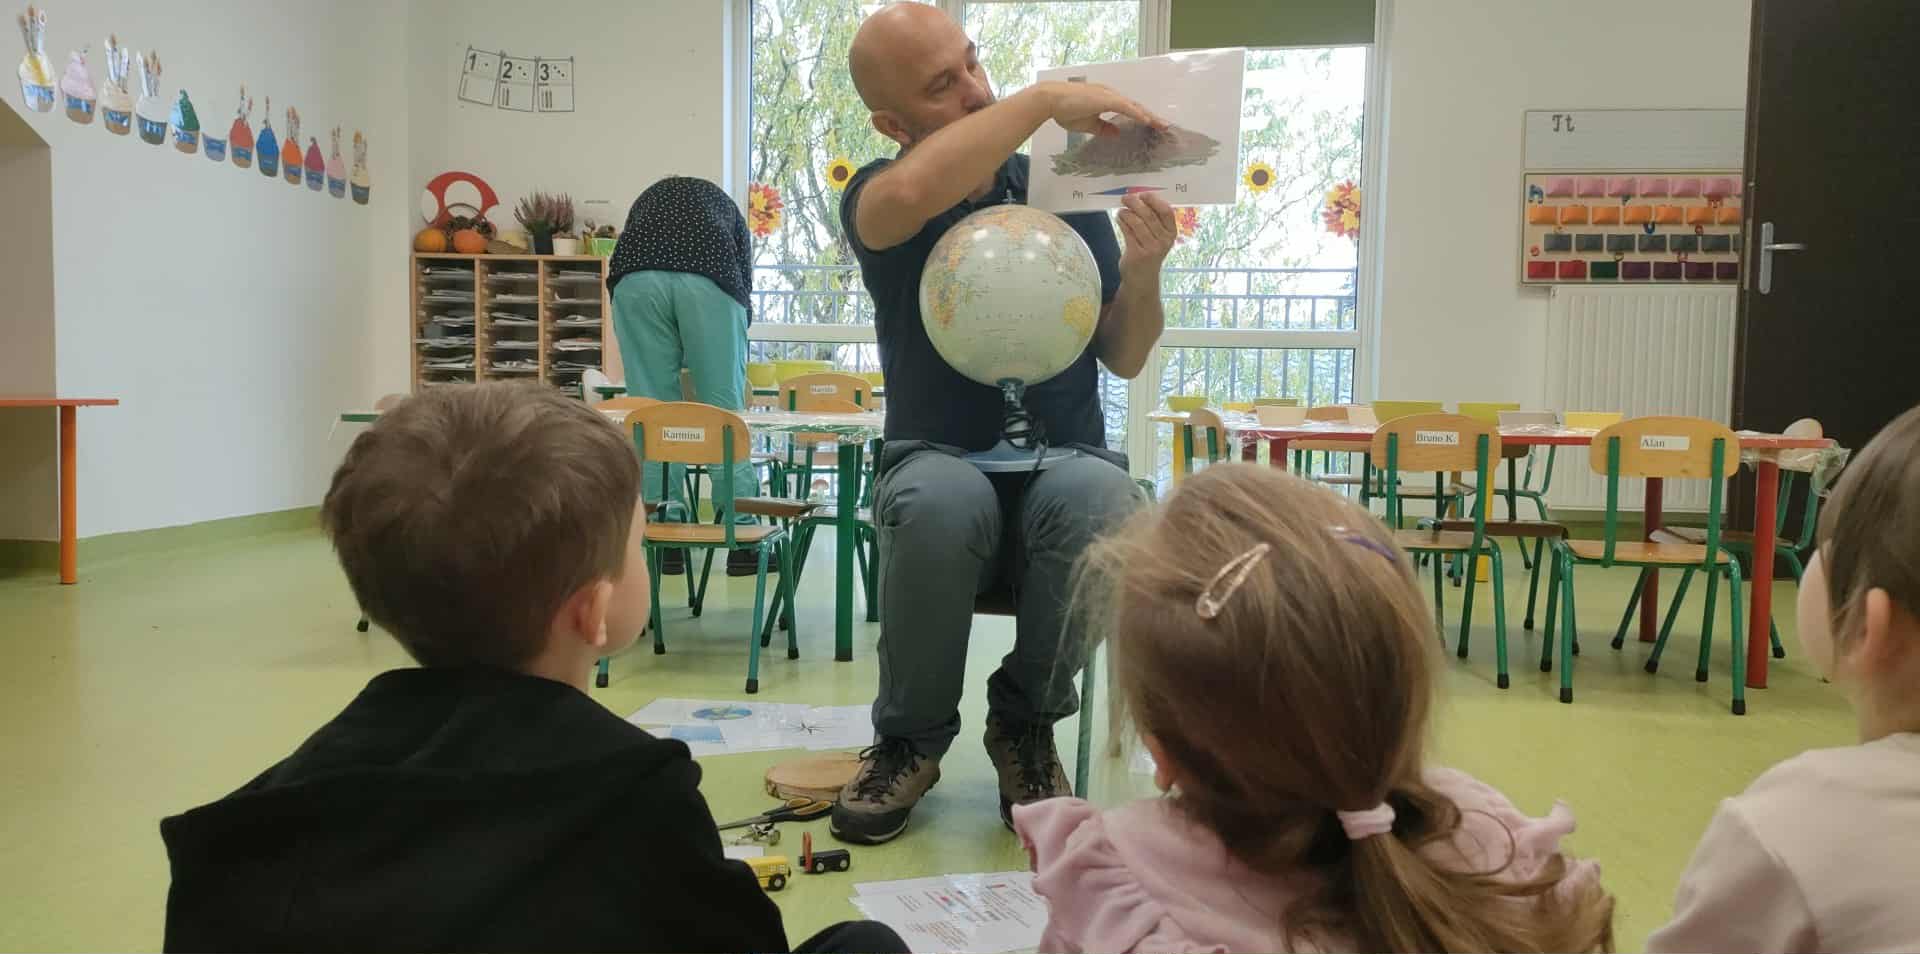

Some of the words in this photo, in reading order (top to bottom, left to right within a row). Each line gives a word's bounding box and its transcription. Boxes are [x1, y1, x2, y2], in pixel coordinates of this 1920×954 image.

[469, 53, 477, 71] 1
[502, 61, 513, 79] 2
[540, 63, 550, 81] 3
[1551, 114, 1576, 132] Tt
[1072, 190, 1084, 200] Pn
[1175, 183, 1188, 193] Pd
[663, 429, 701, 440] Karmina
[1416, 432, 1444, 442] Bruno
[1641, 439, 1665, 448] Alan
